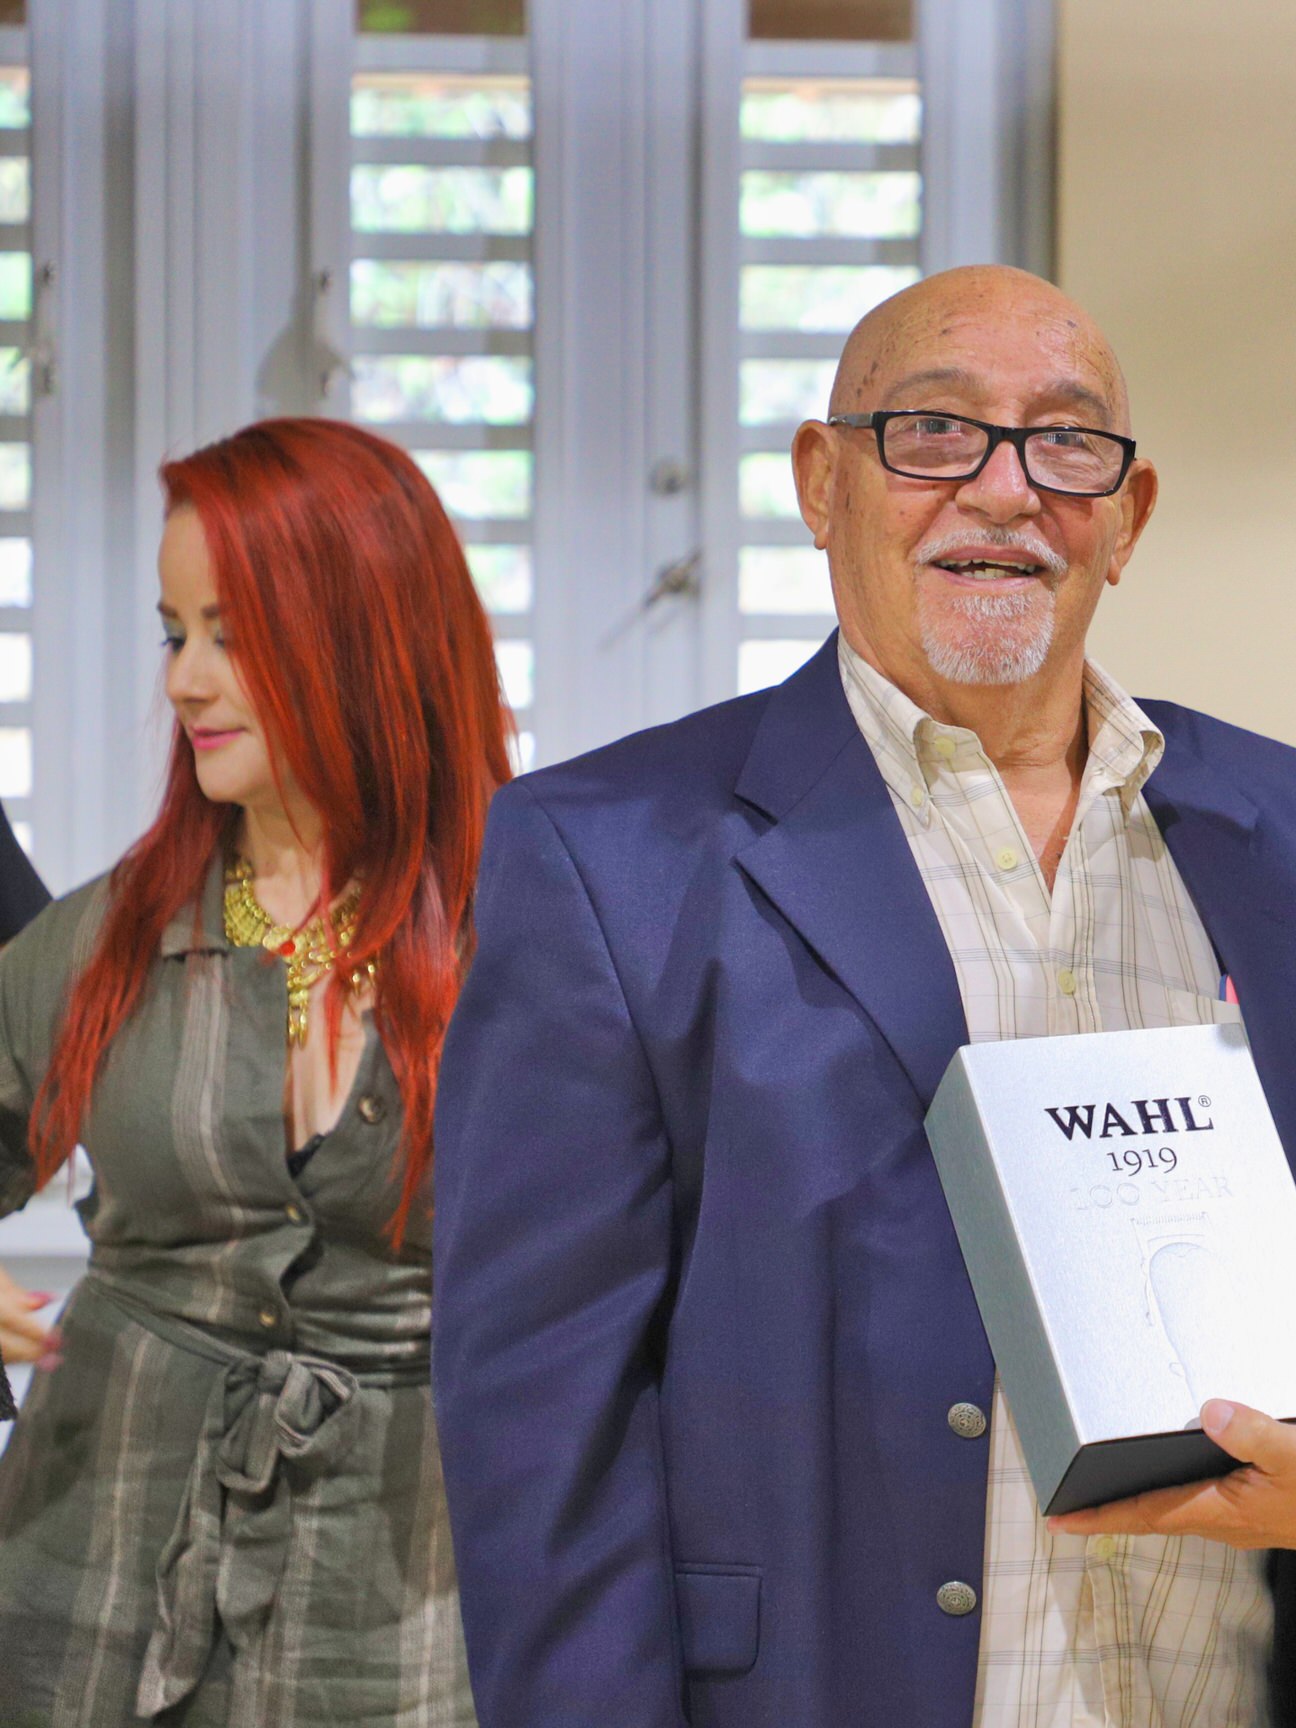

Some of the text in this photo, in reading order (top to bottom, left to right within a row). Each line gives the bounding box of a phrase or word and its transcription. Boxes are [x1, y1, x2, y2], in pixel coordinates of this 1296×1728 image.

[1107, 1147, 1178, 1177] 1919
[1070, 1176, 1234, 1211] 100 YEAR
